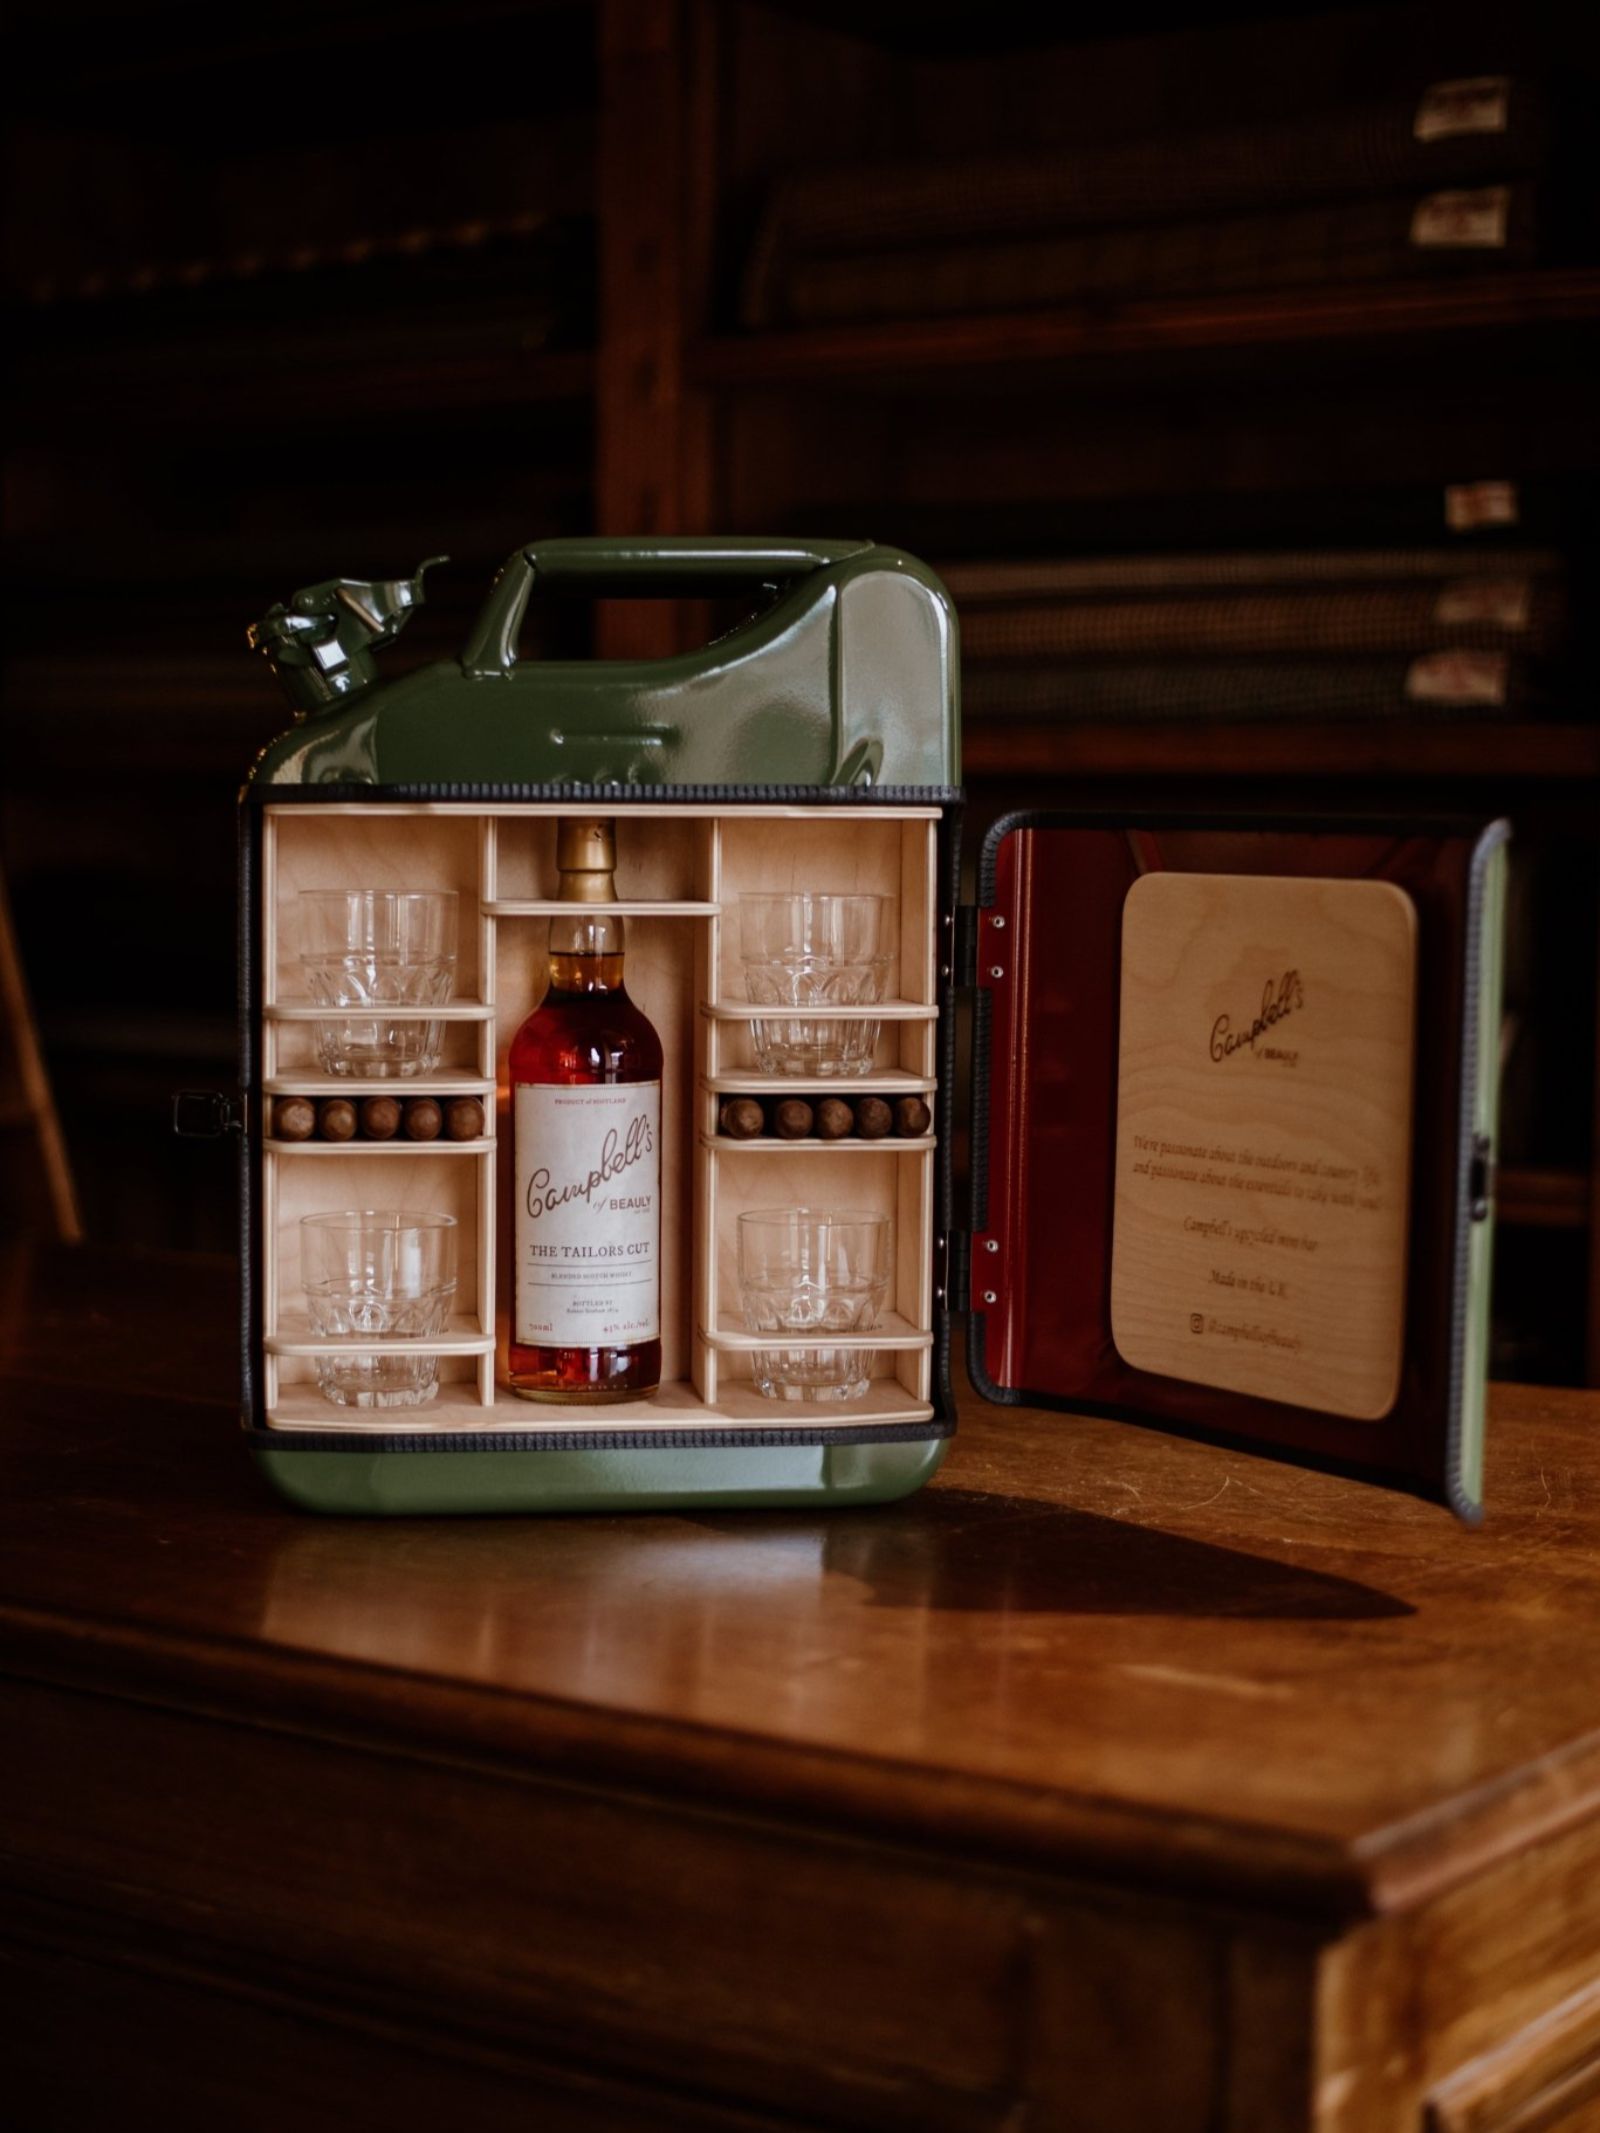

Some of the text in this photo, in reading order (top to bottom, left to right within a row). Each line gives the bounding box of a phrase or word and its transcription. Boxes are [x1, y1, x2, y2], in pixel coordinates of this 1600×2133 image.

[1210, 969, 1303, 1063] Campbell's
[527, 1114, 653, 1218] Campbell's
[1160, 1141, 1207, 1159] passionate
[1209, 1145, 1236, 1163] about
[1238, 1149, 1253, 1165] the
[1299, 1158, 1321, 1175] and
[1133, 1160, 1152, 1174] and
[1150, 1165, 1198, 1183] passionate
[1199, 1168, 1226, 1186] about
[1228, 1172, 1244, 1189] the
[609, 1196, 651, 1210] BEAULY
[529, 1242, 650, 1258] THE TAILORS CUT
